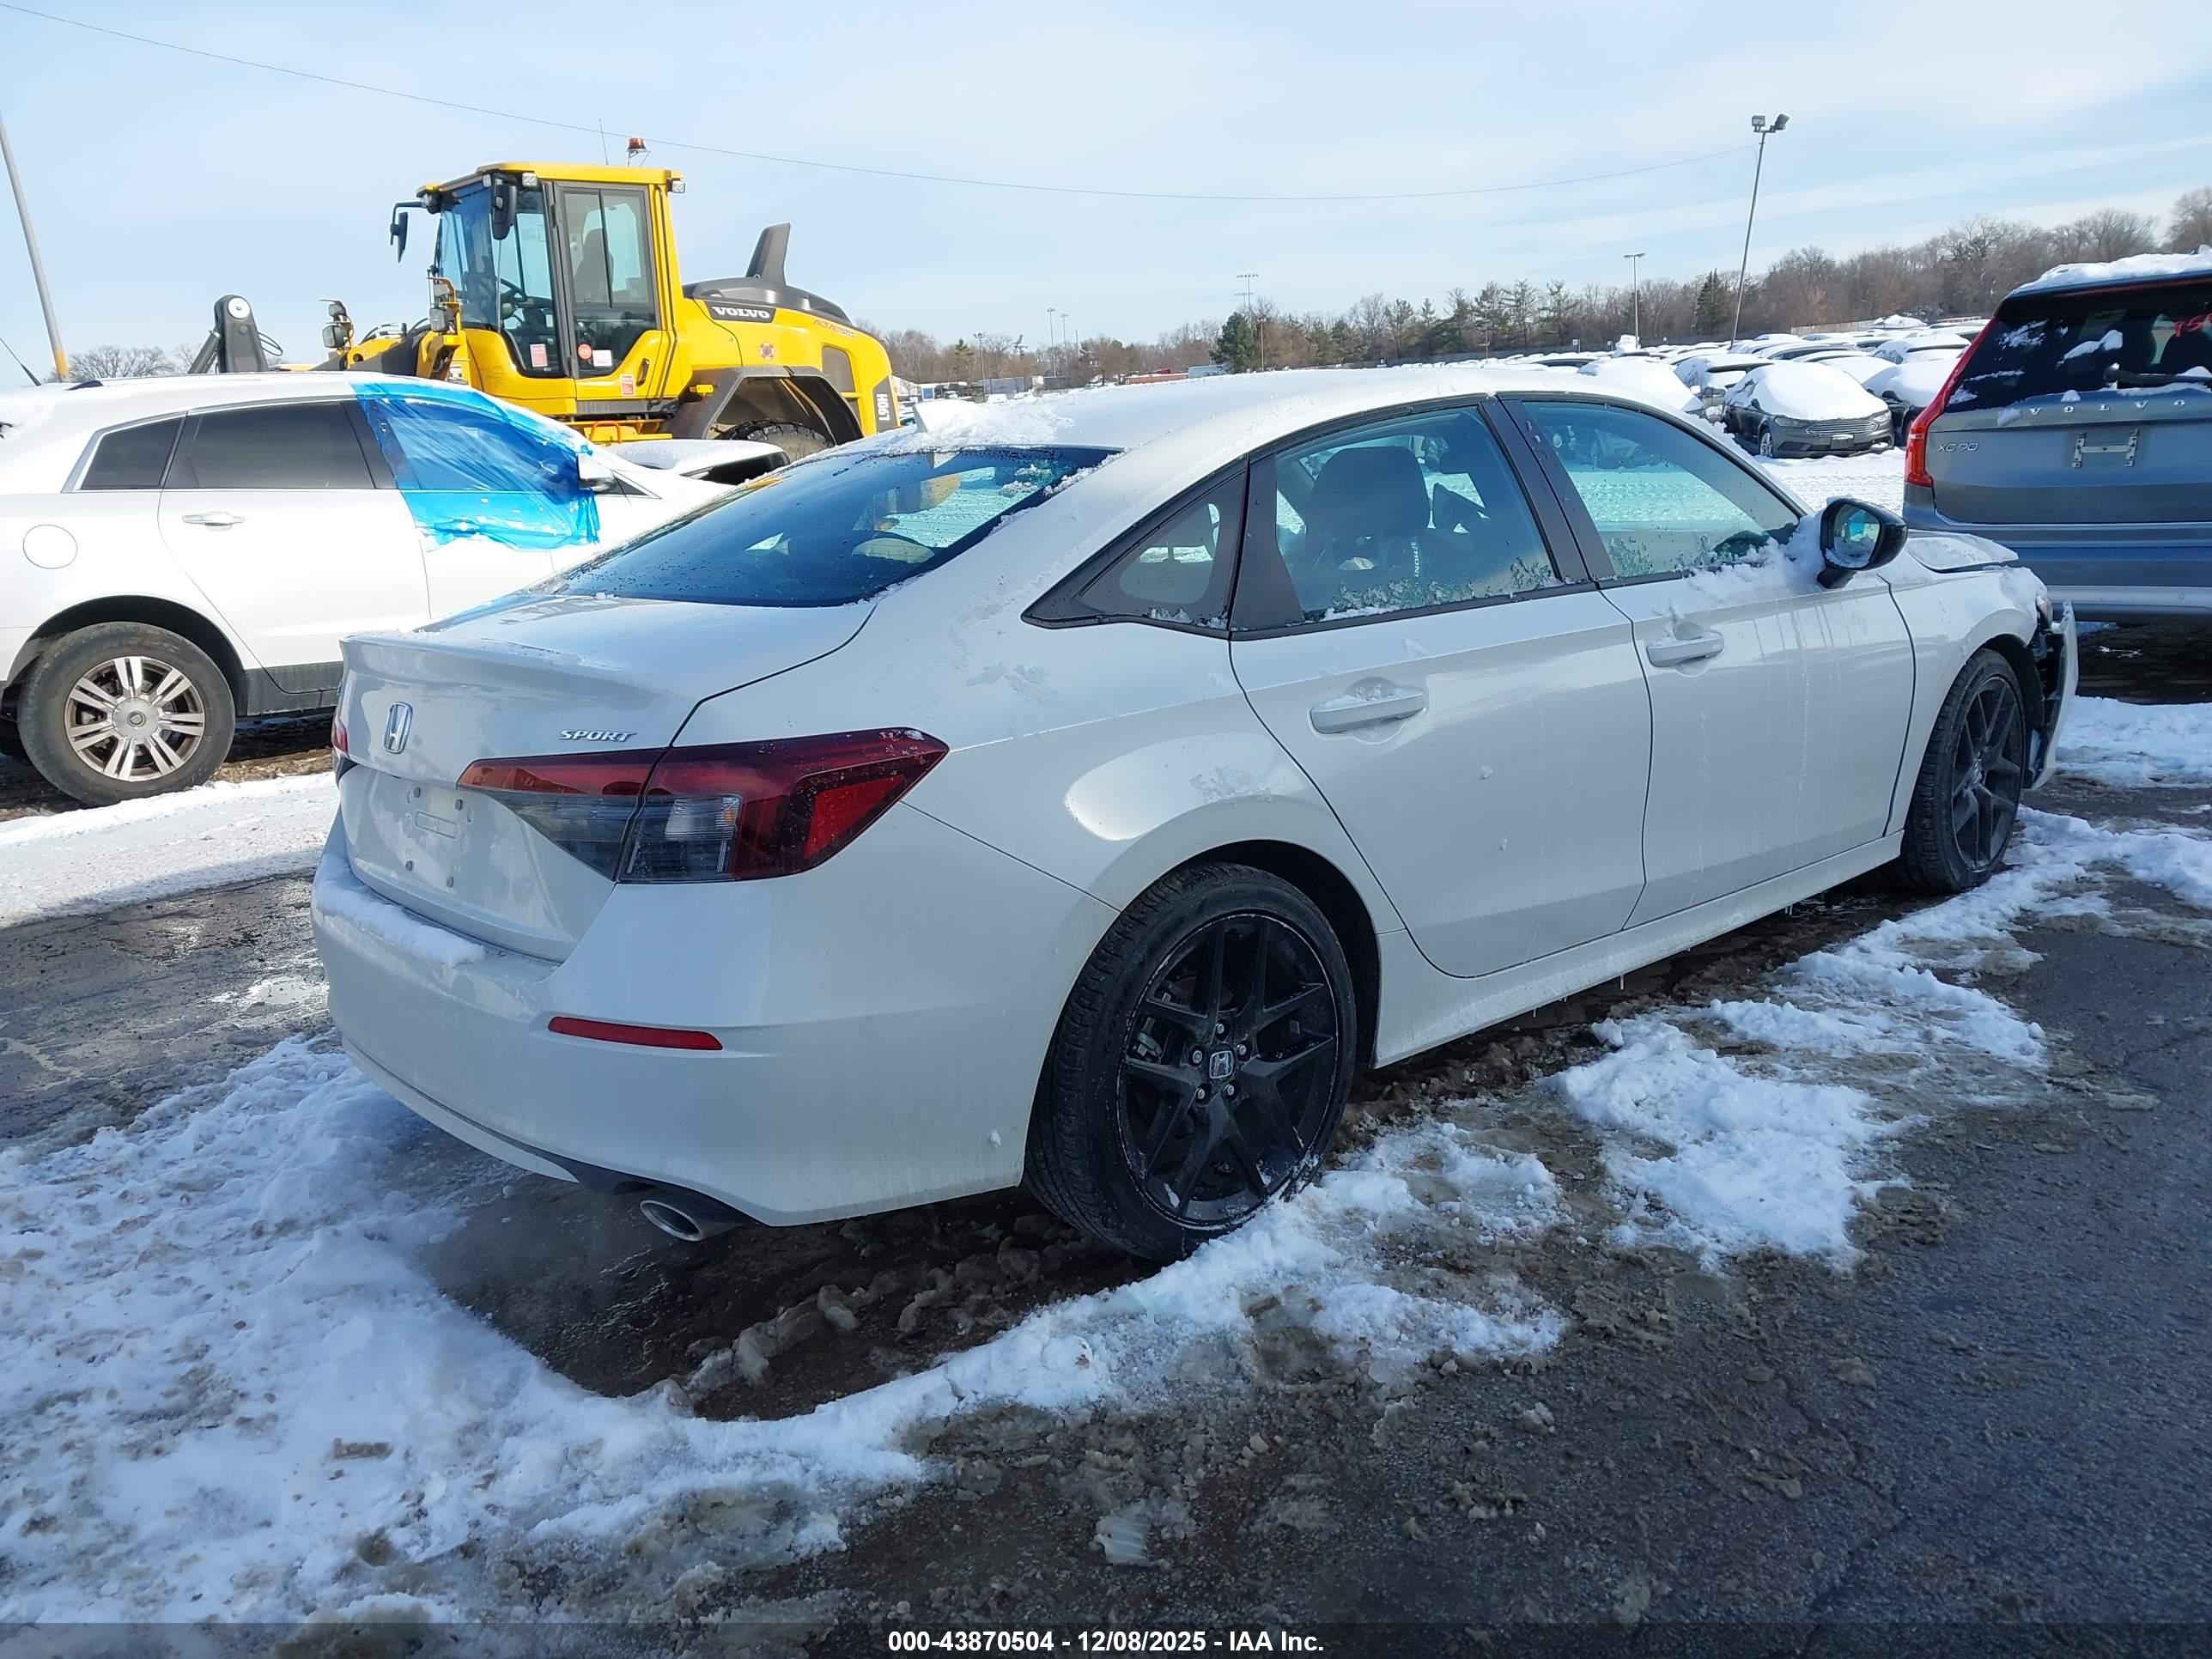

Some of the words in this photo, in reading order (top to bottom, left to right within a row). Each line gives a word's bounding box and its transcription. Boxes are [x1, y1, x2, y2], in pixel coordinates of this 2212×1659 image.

[712, 306, 770, 319] VOLVO
[876, 393, 890, 421] L90H
[2029, 398, 2186, 416] VOLVO
[1936, 443, 1979, 452] XC90
[558, 730, 637, 742] SPORT
